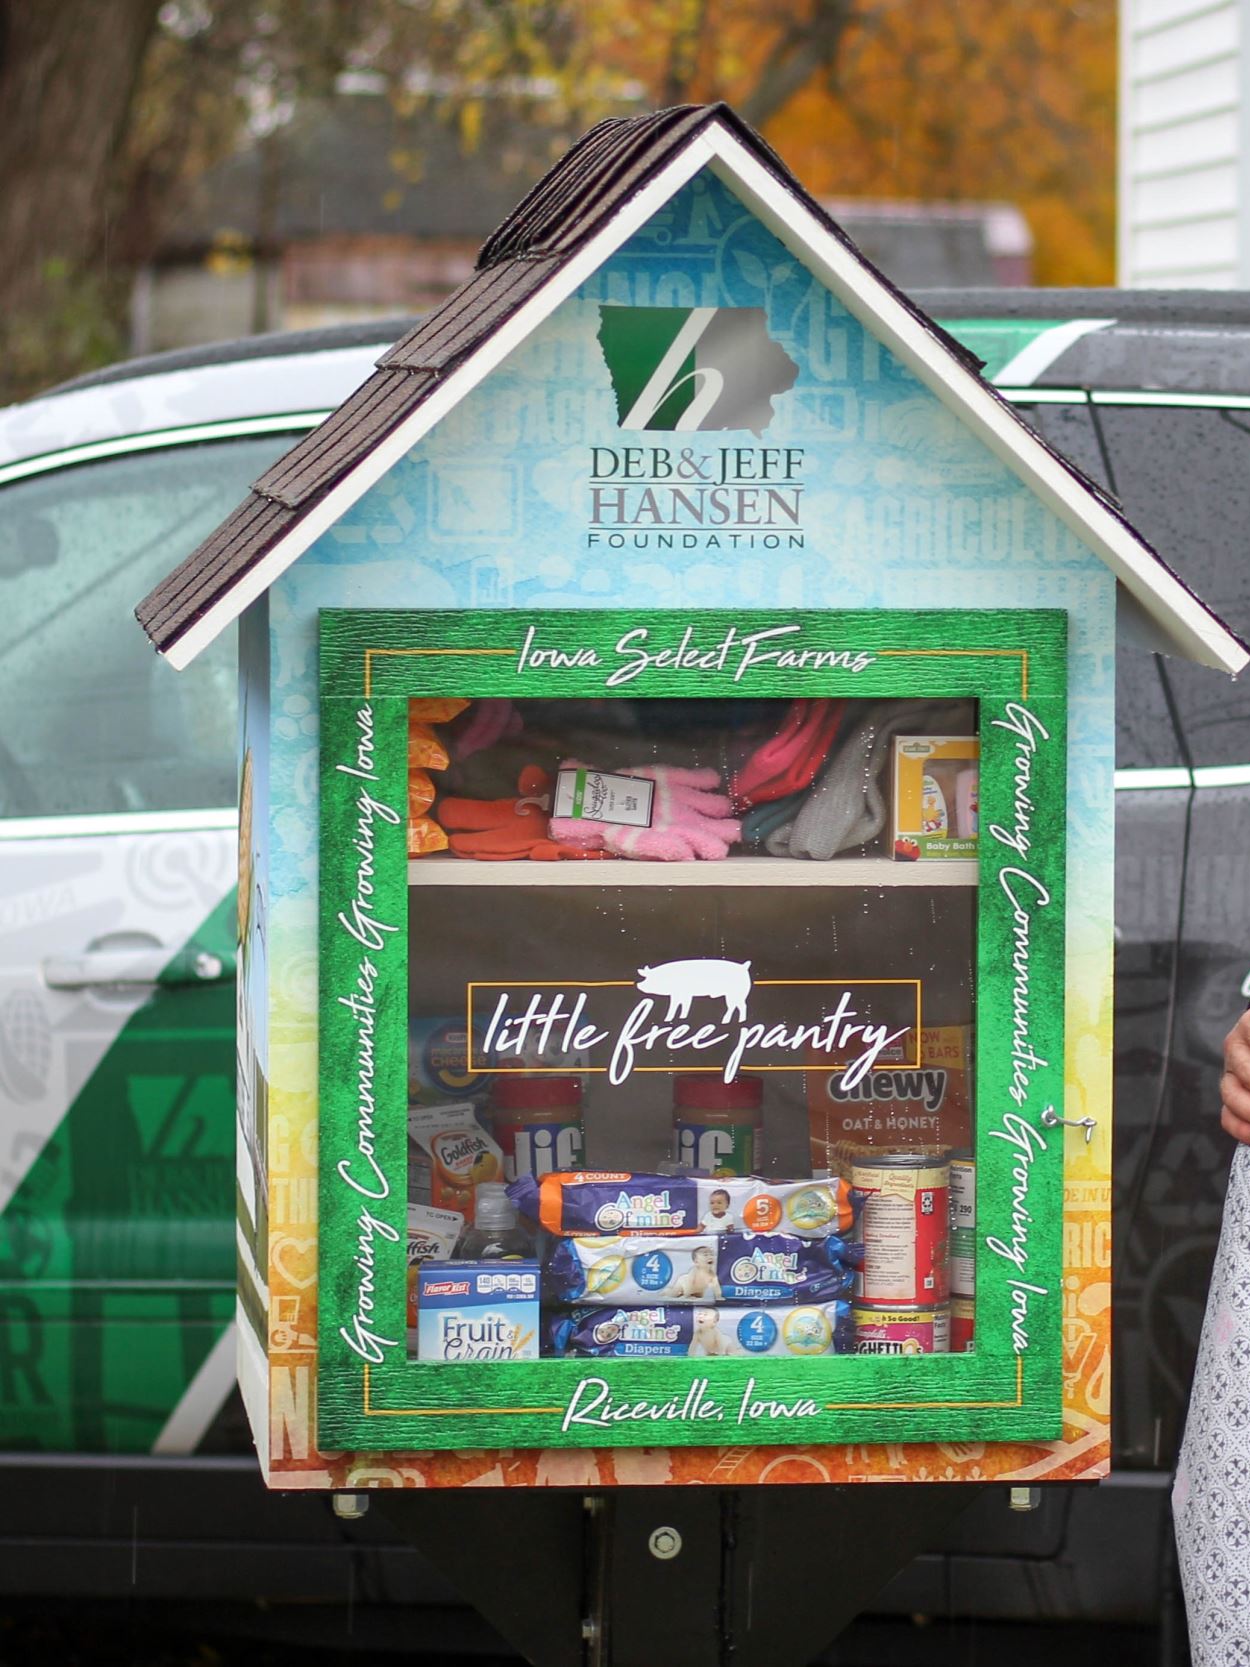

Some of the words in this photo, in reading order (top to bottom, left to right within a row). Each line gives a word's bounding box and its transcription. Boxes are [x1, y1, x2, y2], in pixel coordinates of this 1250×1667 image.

[588, 488, 805, 525] HANSEN
[588, 534, 805, 549] FOUNDATION
[517, 625, 602, 674] Iowa
[605, 625, 740, 687] Select
[733, 625, 877, 682] Farms
[336, 703, 380, 780] Iowa
[990, 702, 1049, 861] Growing
[926, 842, 950, 850] Baby
[953, 842, 975, 850] Bath
[338, 786, 401, 950] Growing
[999, 867, 1050, 1107] Communities
[483, 991, 608, 1054] little
[609, 998, 728, 1086] free
[723, 991, 910, 1091] pantry
[337, 956, 389, 1199] Communities
[842, 1118, 872, 1131] OAT
[886, 1116, 937, 1130] HONEY
[441, 1137, 488, 1166] Goldfish
[574, 1173, 584, 1182] 4
[586, 1172, 627, 1180] COUNT
[616, 1190, 671, 1213] Angel
[986, 1112, 1047, 1275] Growing
[756, 1199, 769, 1216] 5
[646, 1255, 660, 1272] 4
[751, 1246, 798, 1270] Angel
[338, 1205, 400, 1364] Growing
[735, 1286, 782, 1299] Diapers
[443, 1316, 506, 1343] Fruit
[613, 1308, 666, 1326] Angel
[751, 1316, 764, 1334] 4
[1005, 1279, 1048, 1355] Iowa
[443, 1338, 515, 1360] Grain
[625, 1344, 671, 1355] Diapers
[561, 1377, 723, 1432] Riceville,
[737, 1377, 823, 1425] Iowa
